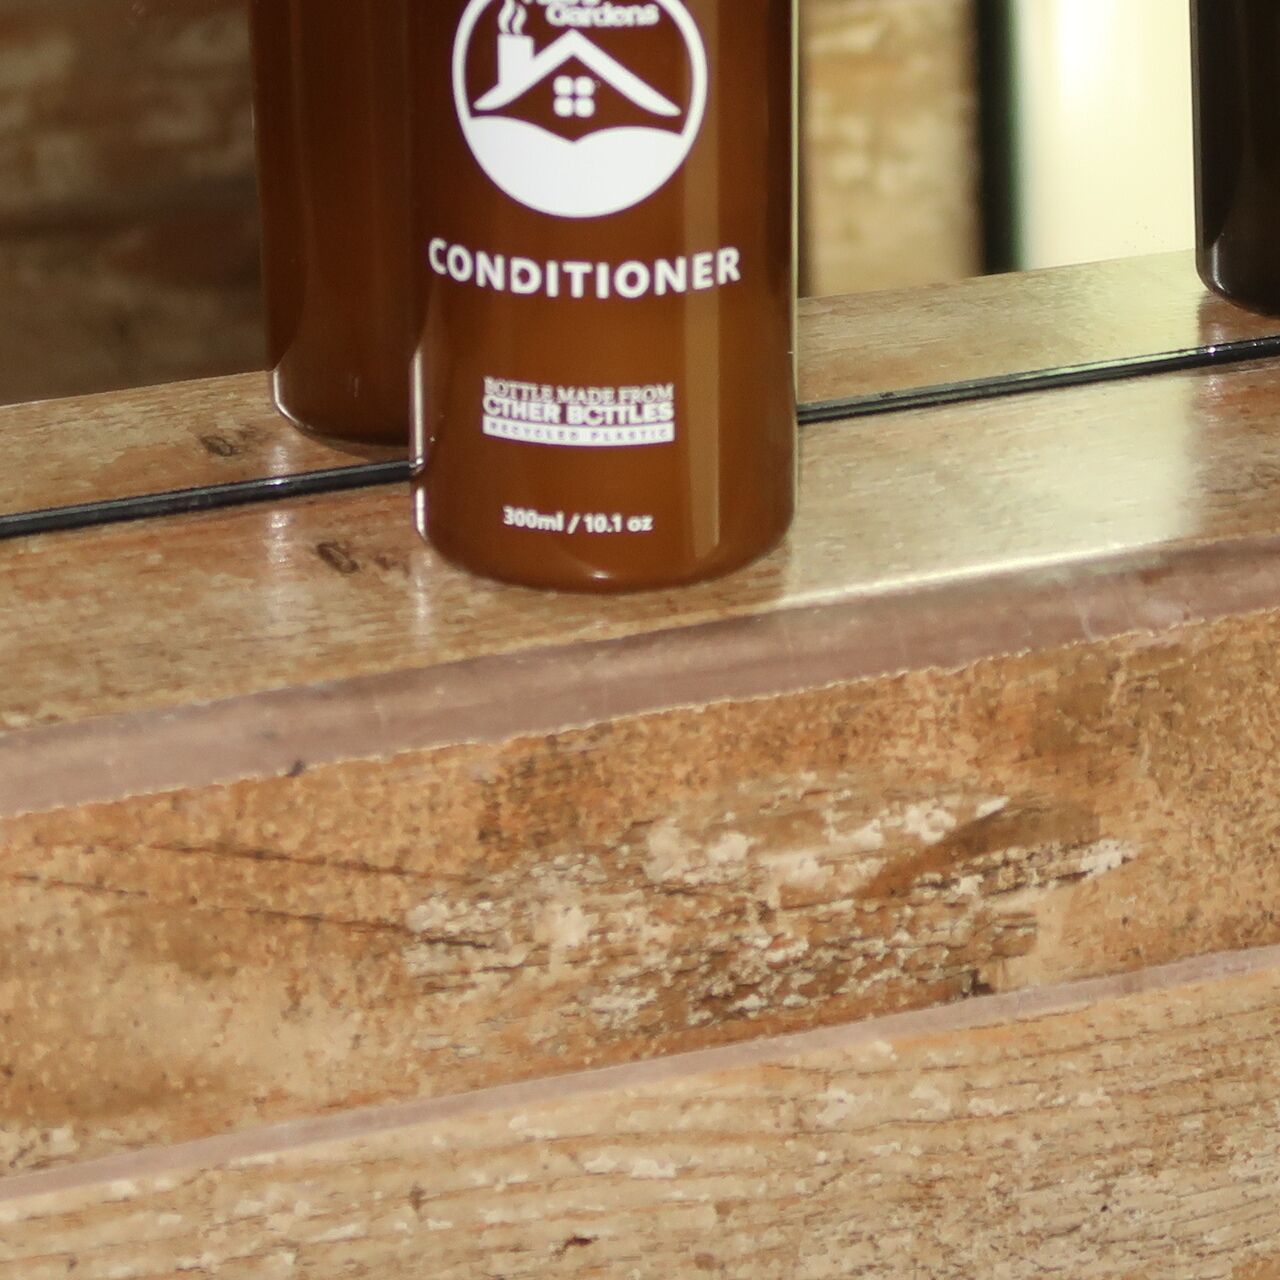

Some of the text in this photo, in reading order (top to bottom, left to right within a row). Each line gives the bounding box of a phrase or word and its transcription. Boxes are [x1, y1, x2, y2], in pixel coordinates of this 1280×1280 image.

[428, 238, 741, 299] CONDITIONER
[557, 385, 615, 405] MADE
[503, 505, 653, 534] 300ml / 10.1 oz
